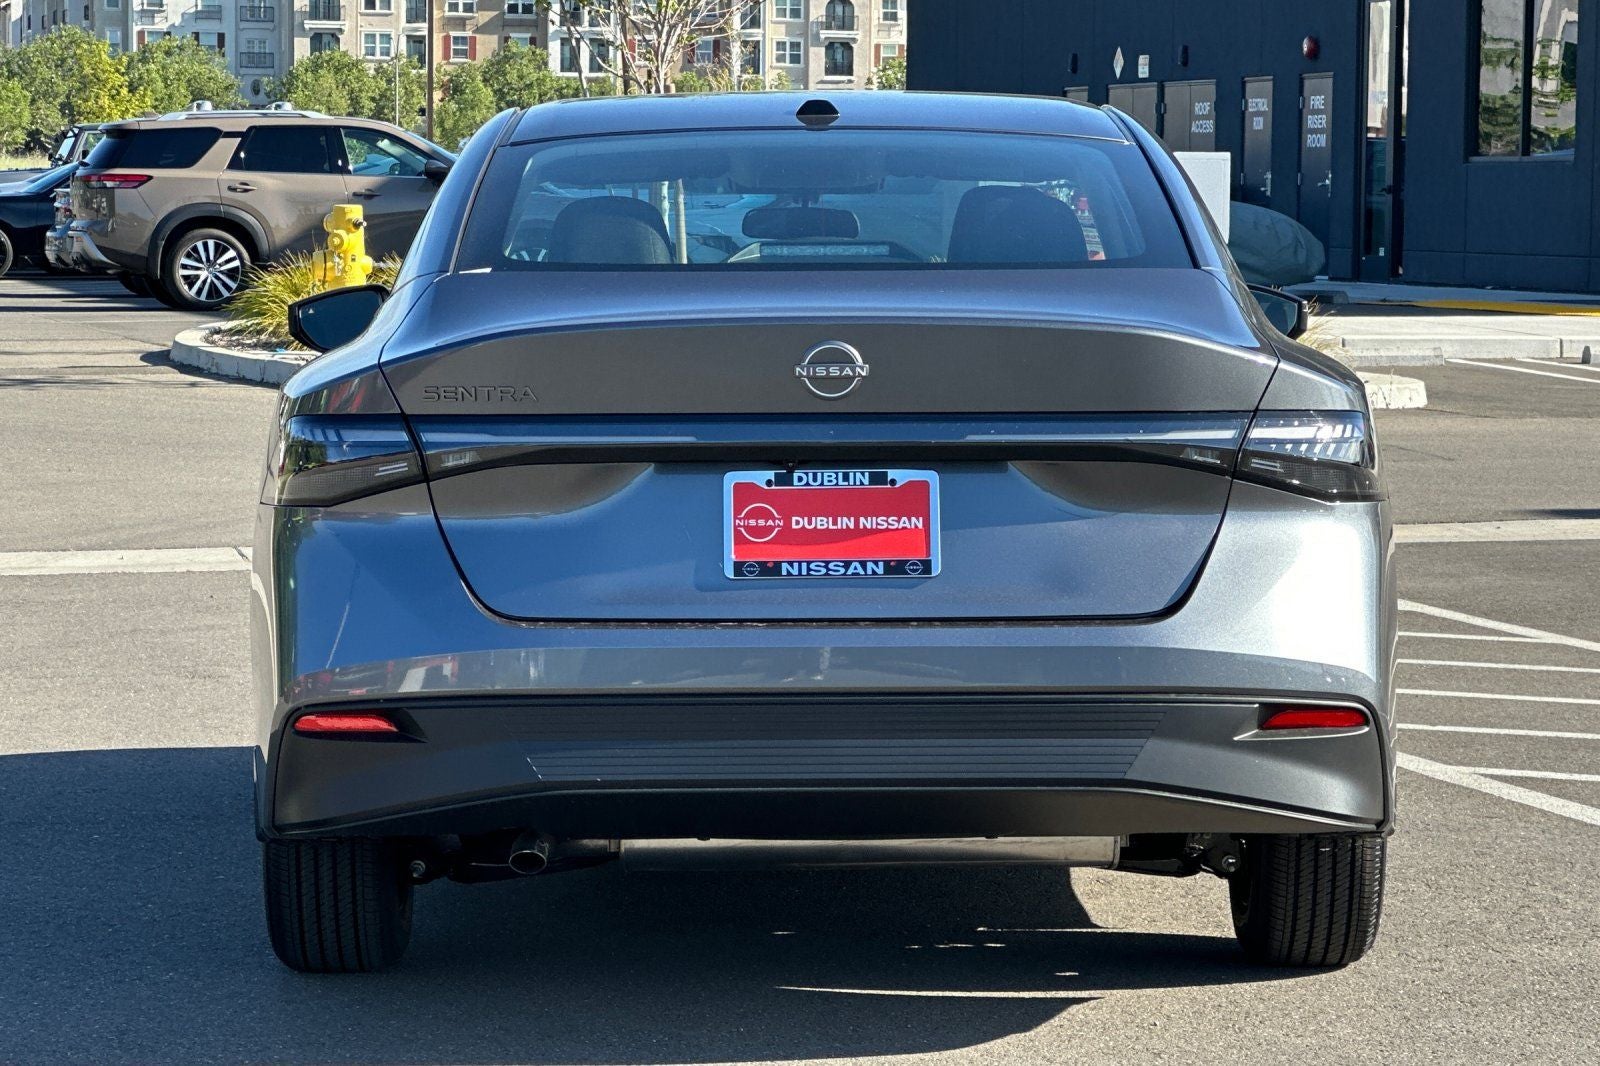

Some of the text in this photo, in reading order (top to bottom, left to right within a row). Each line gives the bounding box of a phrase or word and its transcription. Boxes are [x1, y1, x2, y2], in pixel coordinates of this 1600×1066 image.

[1194, 102, 1211, 115] ROOF
[1310, 95, 1325, 109] FIRE
[1191, 119, 1214, 133] ACCESS
[1307, 114, 1327, 129] RISER
[1307, 133, 1326, 148] ROOM
[795, 366, 867, 376] NISSAN
[422, 385, 539, 402] SENTRA
[792, 471, 870, 487] DUBLIN
[791, 516, 924, 530] DUBLIN NISSAN
[781, 561, 884, 576] NISSAN
